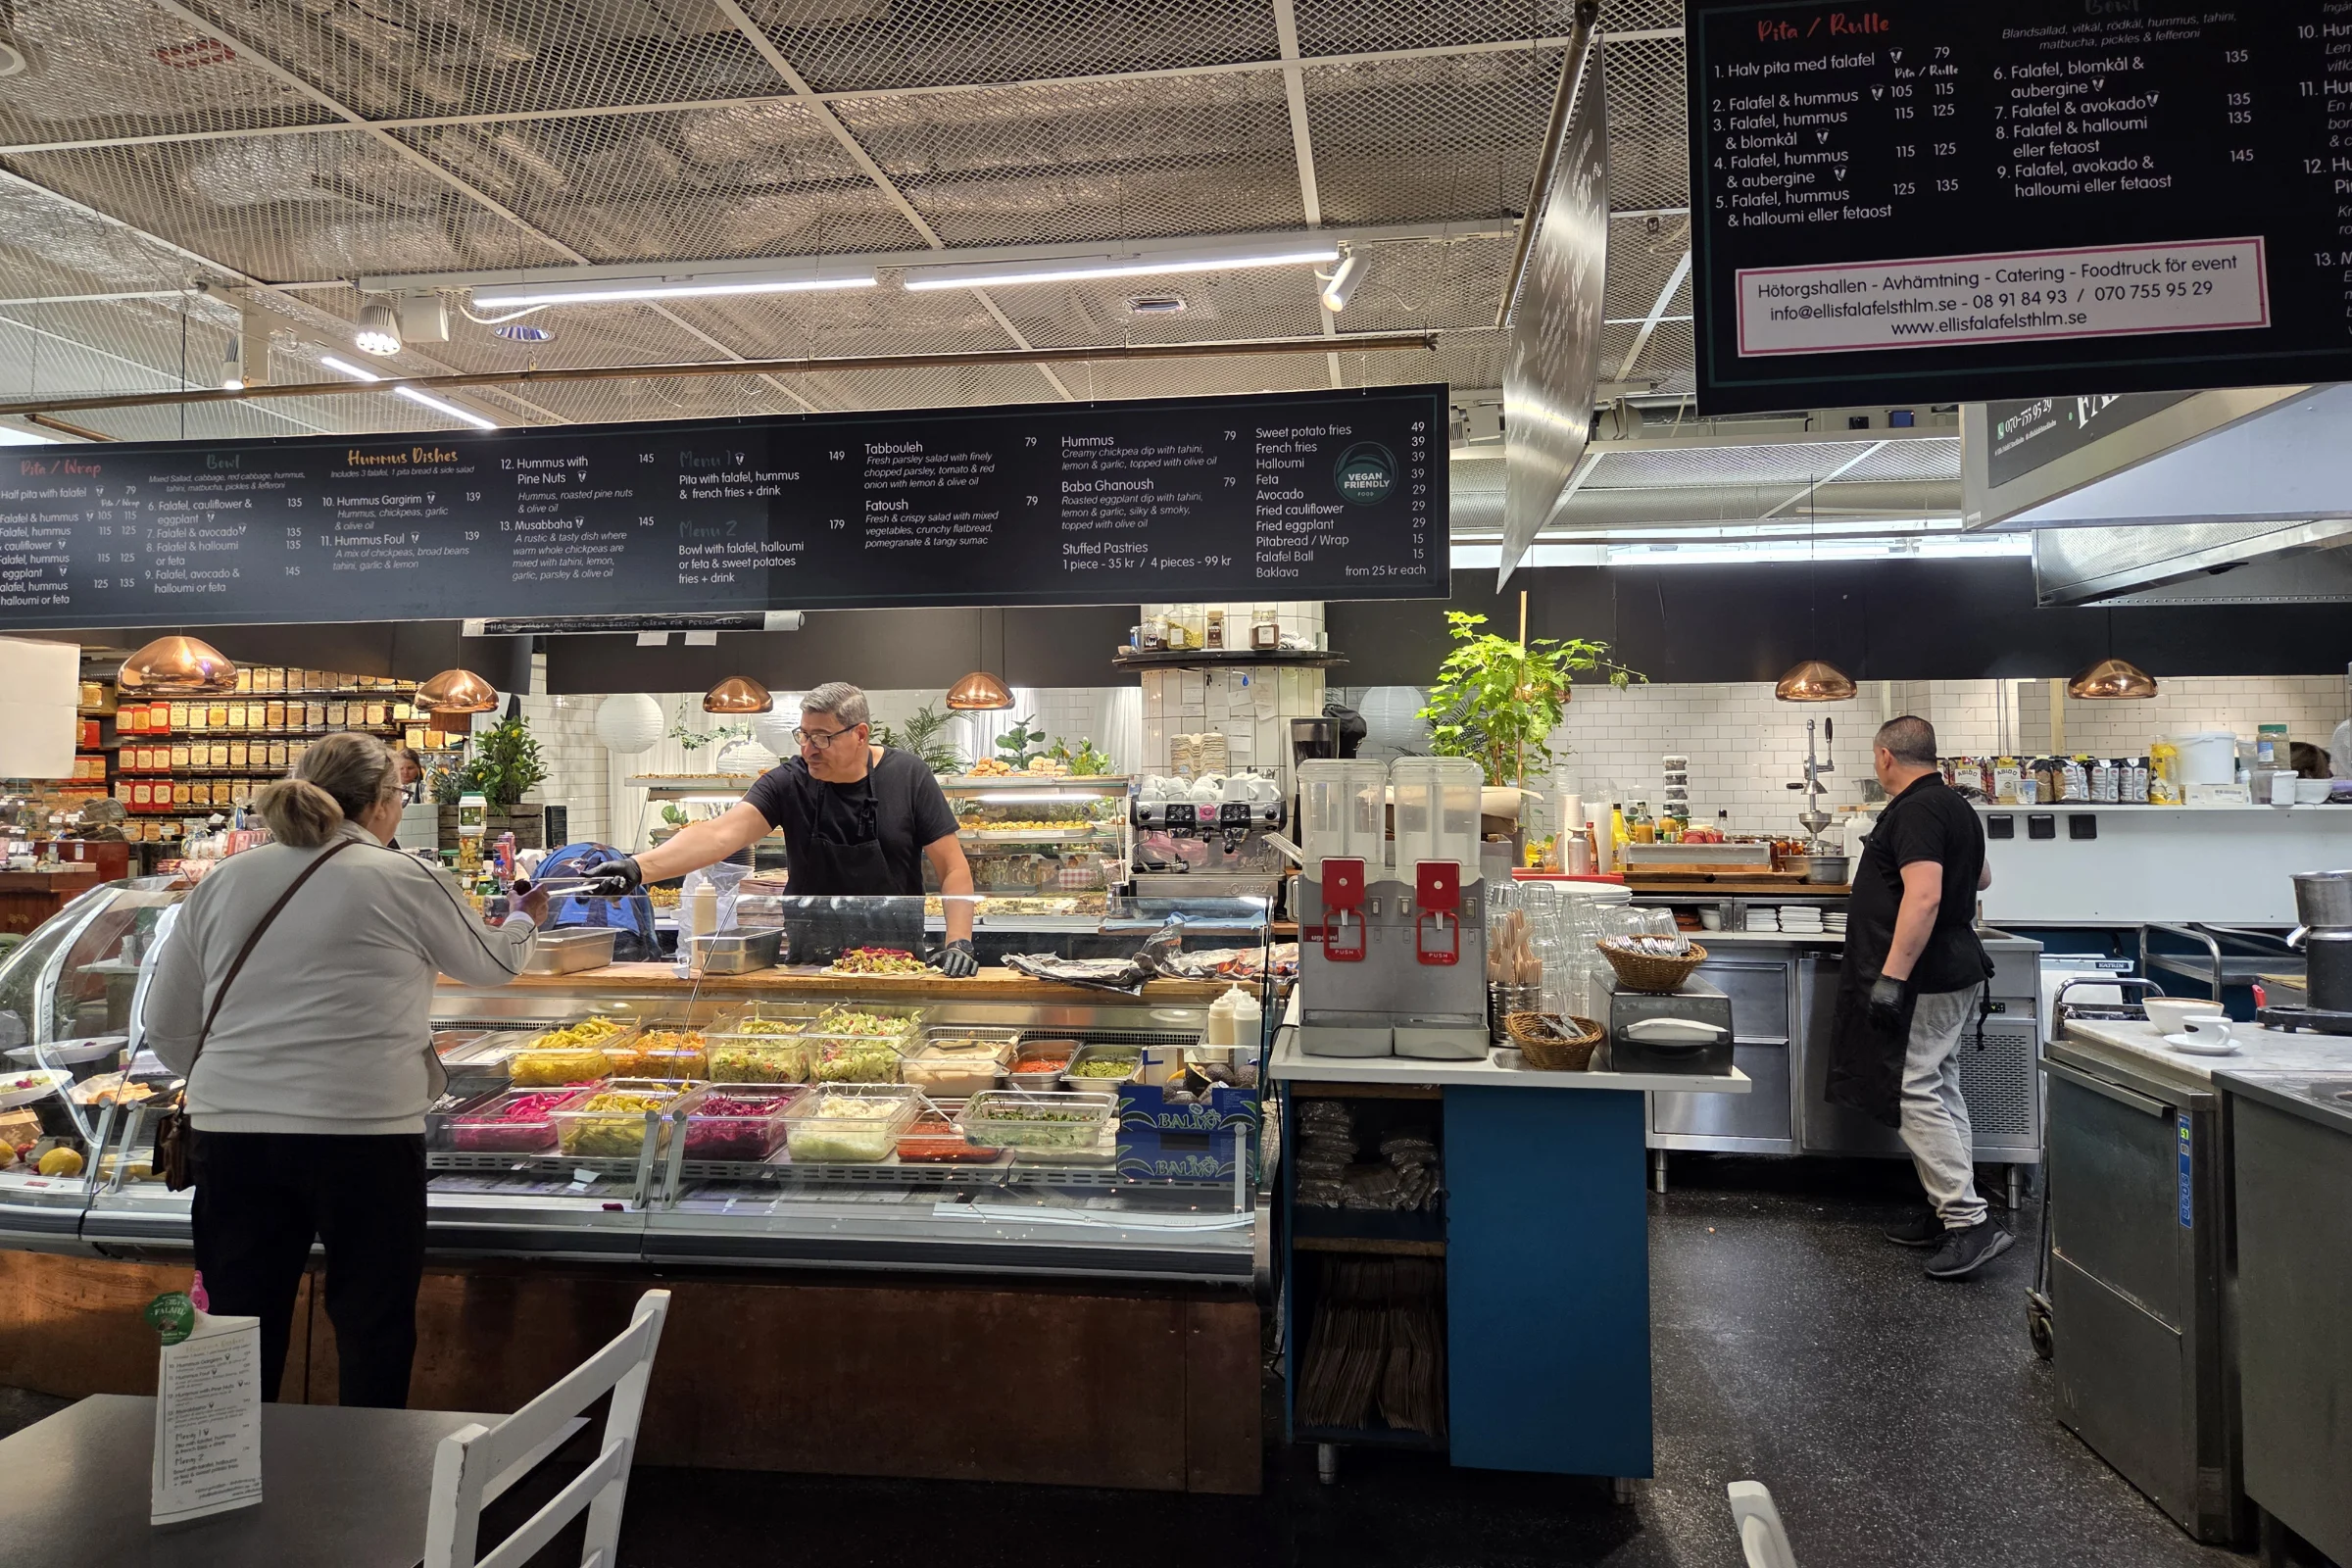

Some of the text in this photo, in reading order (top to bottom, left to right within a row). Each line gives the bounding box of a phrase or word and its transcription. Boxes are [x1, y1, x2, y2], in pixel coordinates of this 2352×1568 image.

[1758, 21, 1797, 41] Pita
[1831, 13, 1888, 35] Rulle
[2002, 13, 2235, 39] Blandsallad, vitkål, rödkål, hummus, tahini,
[1715, 47, 1949, 77] 1. Halv pita med falafel 79
[1993, 50, 2248, 79] 6. Falafel, blomkål & 135
[1713, 83, 1954, 112] 2. Falafel & hummus 105 115
[2011, 82, 2087, 98] aubergine
[1995, 93, 2250, 120] 7. Falafel & avokado 135
[1716, 179, 1958, 208] 5. Falafel, hummus 125 135
[1728, 205, 1891, 226] & halloumi eller fetaost
[1759, 278, 1866, 301] Hötorgshallen
[1883, 273, 1979, 293] Avhämtning
[1996, 268, 2064, 285] Catering
[2082, 259, 2161, 278] Foodtruck
[2165, 258, 2186, 273] för
[2191, 256, 2236, 270] event
[1771, 298, 1956, 320] info@ellisfalafelsthlm.se
[1973, 294, 1993, 309] 08
[1999, 293, 2015, 307] 91
[2022, 291, 2041, 306] 84
[2047, 290, 2067, 304] 93
[2078, 288, 2084, 303] /
[2095, 286, 2125, 301] 070
[2131, 284, 2159, 299] 755
[2165, 282, 2186, 297] 95
[2192, 280, 2213, 295] 29
[1891, 312, 2086, 335] www.ellisfalafelsthlm.se
[1256, 421, 1424, 439] Sweet potato fries 49
[864, 437, 1037, 454] Tabbouleh 79
[1062, 431, 1236, 447] Hummus 79
[1256, 436, 1425, 454] French fries 39
[348, 448, 458, 466] Hummus Dishes
[501, 454, 654, 469] 12. Hummus with 145
[867, 452, 992, 466] Fresh parsley salad with finely
[1256, 452, 1425, 468] Halloumi 39
[23, 462, 45, 475] Pita
[67, 461, 100, 476] Wrap
[1256, 468, 1424, 484] Feta 39
[518, 473, 565, 484] Pine Nuts
[680, 471, 800, 485] Pita with falafel, hummus
[1062, 477, 1236, 492] Baba Ghanoush 79
[322, 492, 480, 507] 10. Hummus Gargirim 139
[679, 490, 687, 499] &
[693, 488, 722, 498] french
[724, 487, 745, 497] fries
[757, 485, 780, 496] drink
[1256, 484, 1426, 500] Avocado 29
[866, 496, 1038, 511] Fatoush 79
[1256, 501, 1425, 515] Fried cauliflower 29
[500, 516, 654, 531] 13. Musabbaha 145
[1256, 517, 1426, 533] Fried eggplant 29
[1063, 542, 1148, 555] Stuffed Pastries
[1256, 534, 1423, 547] Pitabread / Wrap 15
[1256, 549, 1424, 562] Falafel Ball 15
[1256, 564, 1426, 577] Baklava from 25 kr each
[155, 583, 194, 593] halloumi
[209, 582, 225, 592] feta
